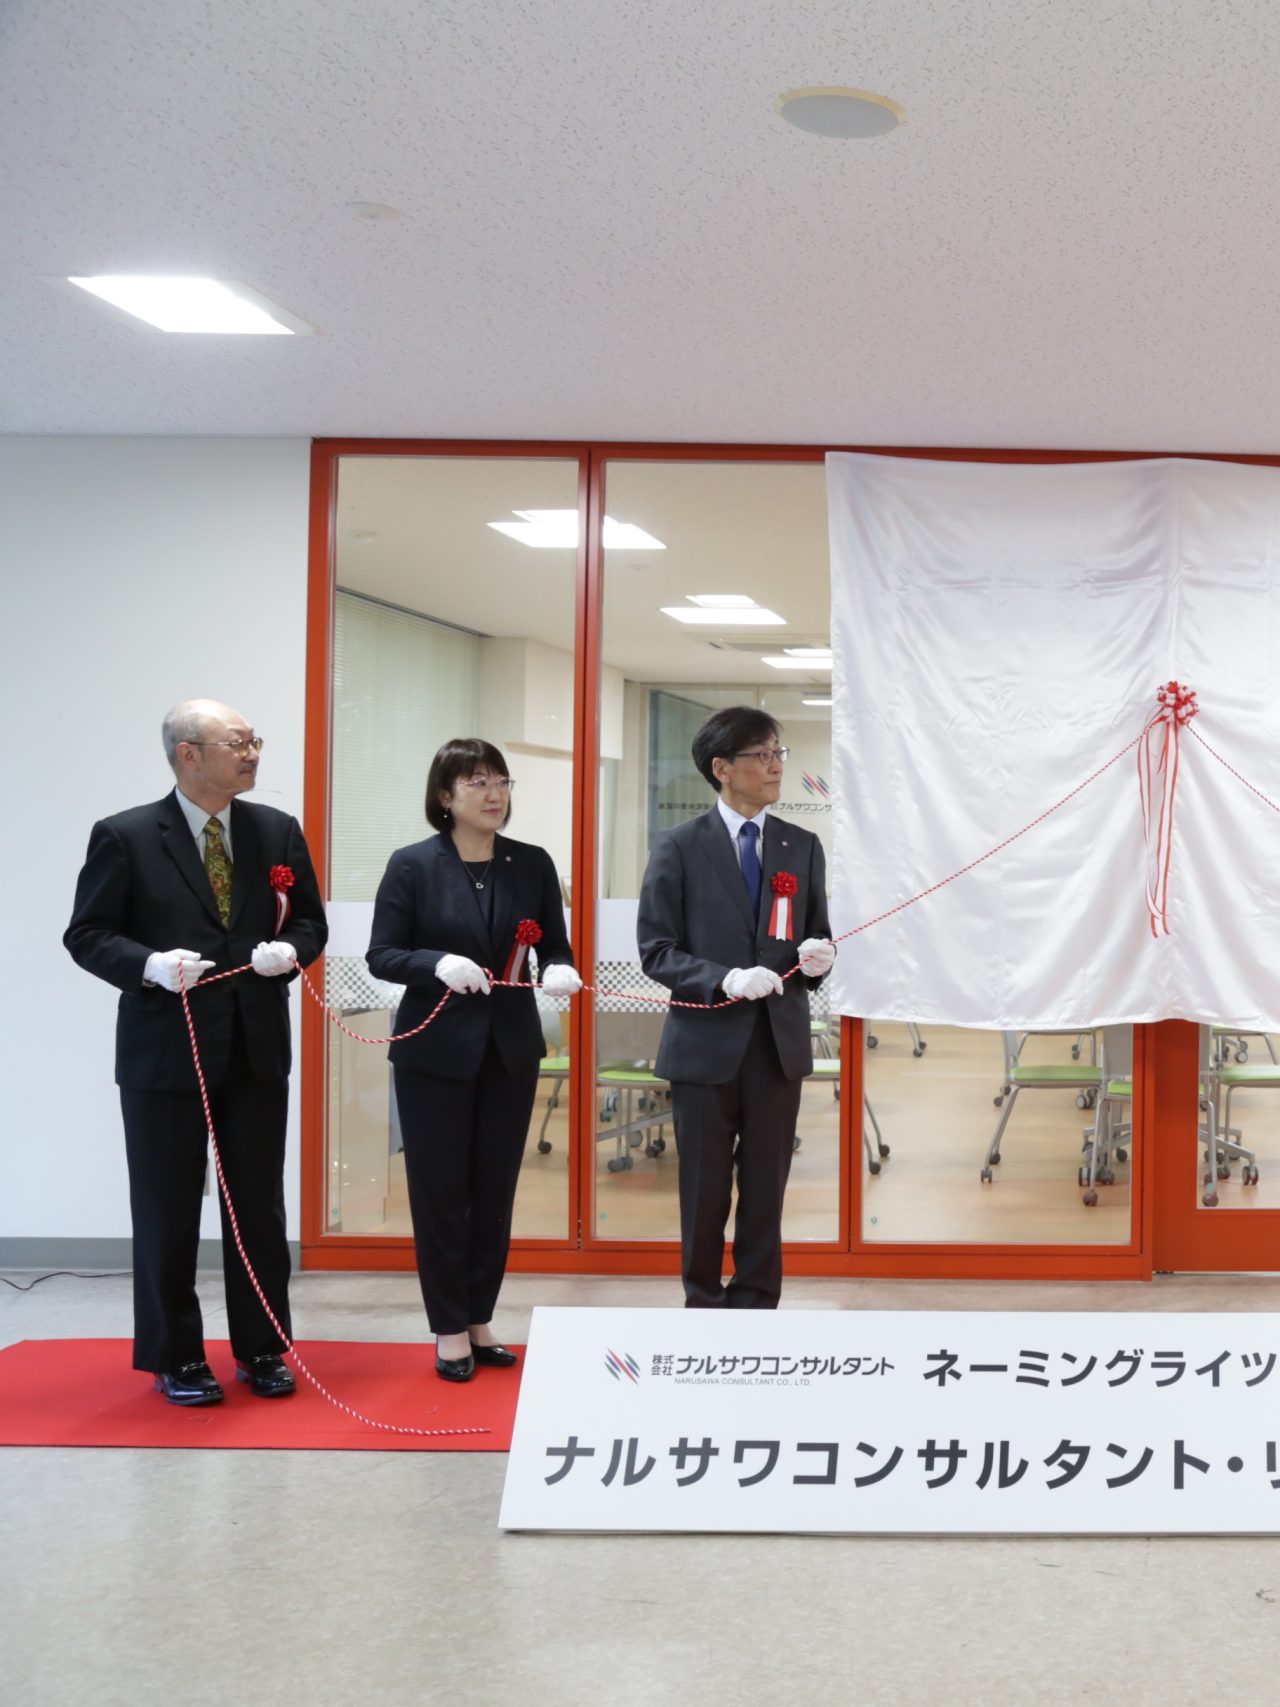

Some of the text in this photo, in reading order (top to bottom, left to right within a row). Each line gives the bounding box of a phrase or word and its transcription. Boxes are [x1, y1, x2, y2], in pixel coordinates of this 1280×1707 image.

[652, 1354, 674, 1365] 株式
[651, 1365, 673, 1376] 会社
[676, 1355, 895, 1376] ナルサワコンサルタント
[674, 1377, 720, 1386] NARUSAWA
[721, 1377, 775, 1386] CONSULTANT
